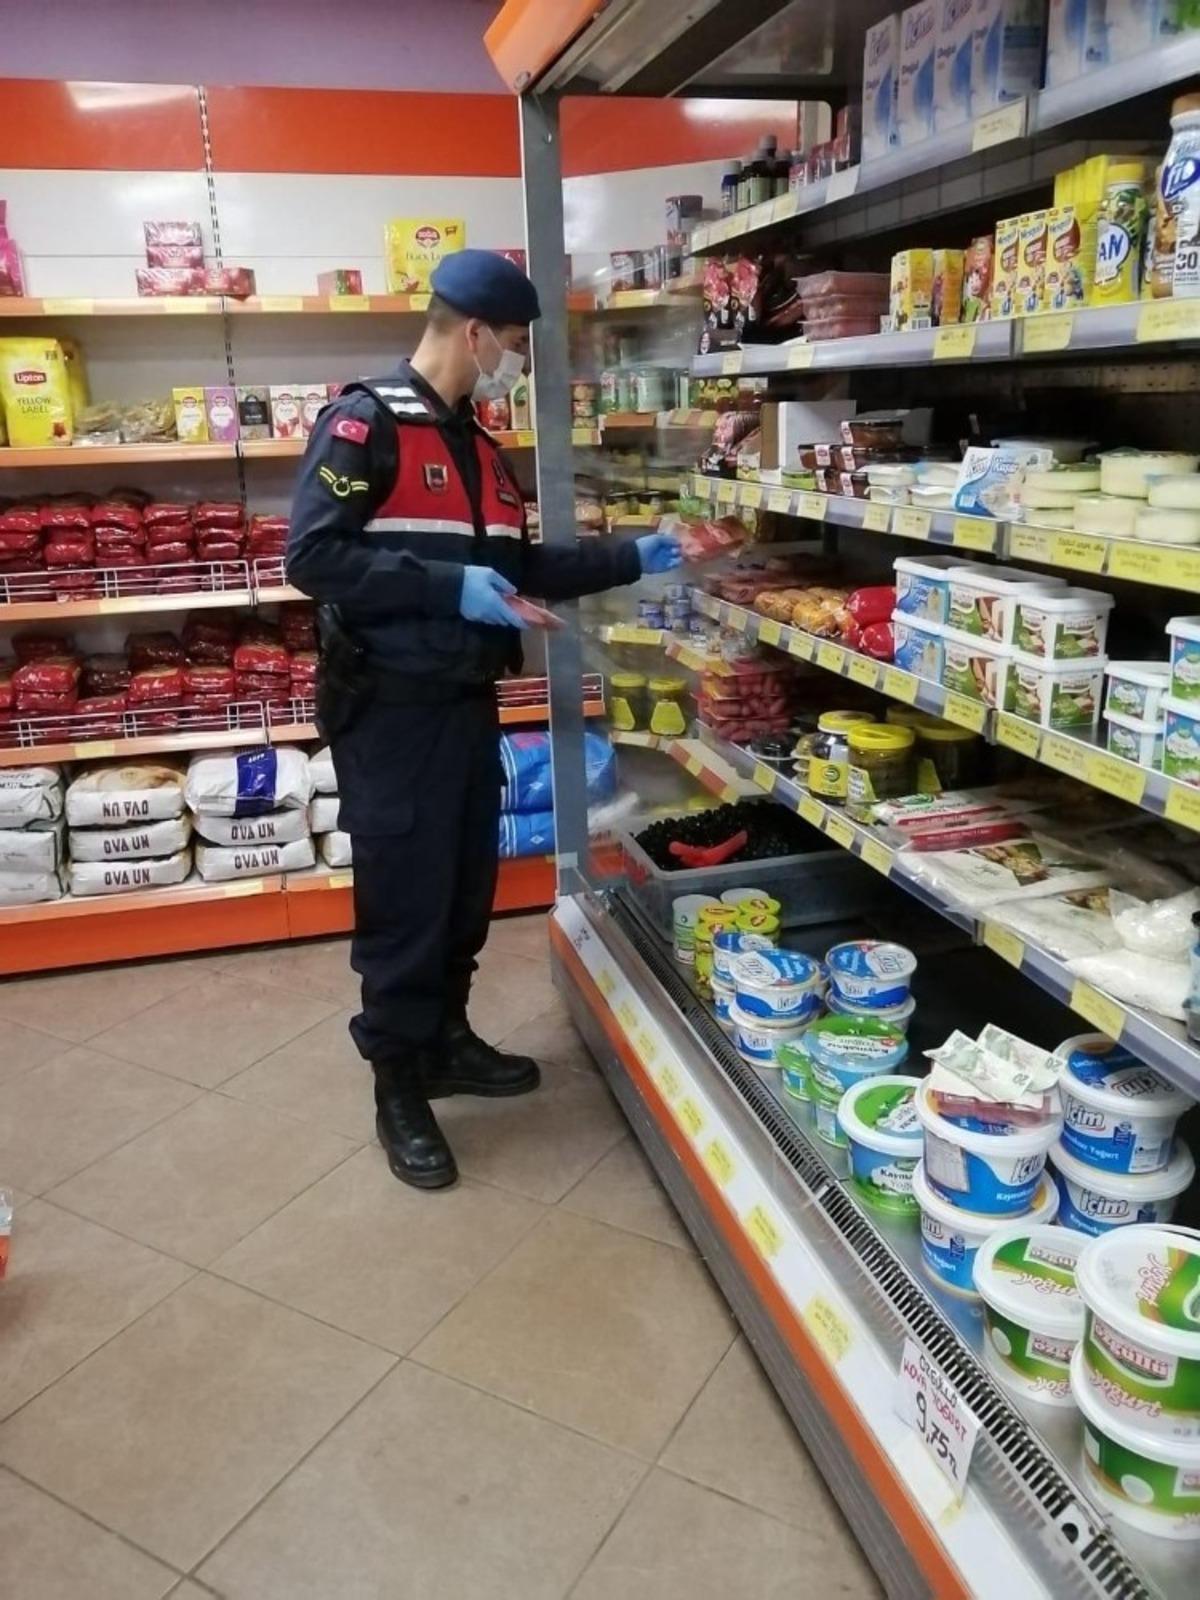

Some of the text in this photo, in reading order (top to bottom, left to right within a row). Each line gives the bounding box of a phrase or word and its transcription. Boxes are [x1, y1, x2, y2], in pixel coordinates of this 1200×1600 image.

[17, 396, 51, 406] YELLOW
[22, 405, 49, 413] LABEL
[102, 800, 149, 818] OVA UN
[231, 822, 276, 840] OVA UN
[103, 834, 150, 854] OVA UN
[234, 850, 279, 869] OVA UN
[104, 868, 150, 886] OVA UN
[1012, 1072, 1027, 1086] 20
[880, 1168, 913, 1180] Kayma
